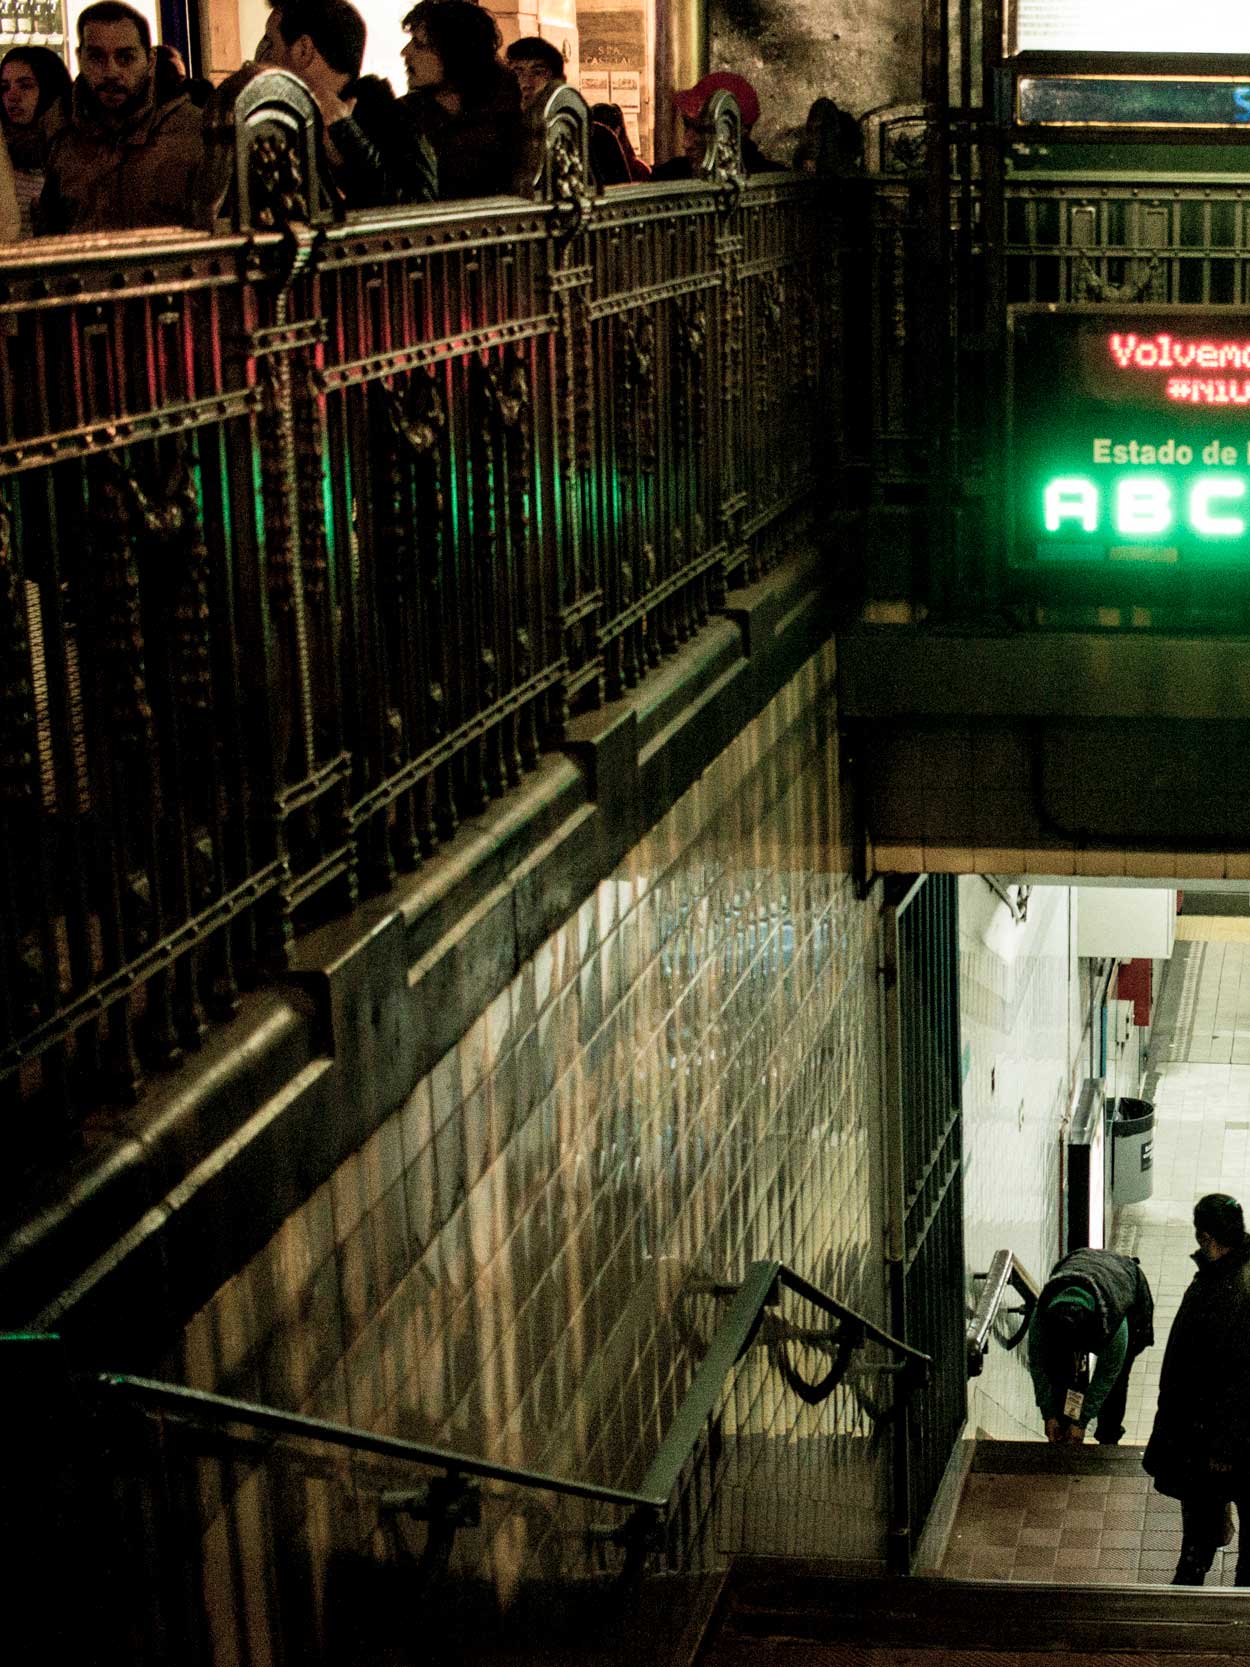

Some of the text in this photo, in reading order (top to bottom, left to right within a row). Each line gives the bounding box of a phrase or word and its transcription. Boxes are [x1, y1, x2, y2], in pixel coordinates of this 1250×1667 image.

[1093, 438, 1193, 465] Estado
[1202, 440, 1237, 465] de
[1045, 478, 1098, 532] A
[1115, 477, 1172, 536] B
[1189, 477, 1246, 536] C
